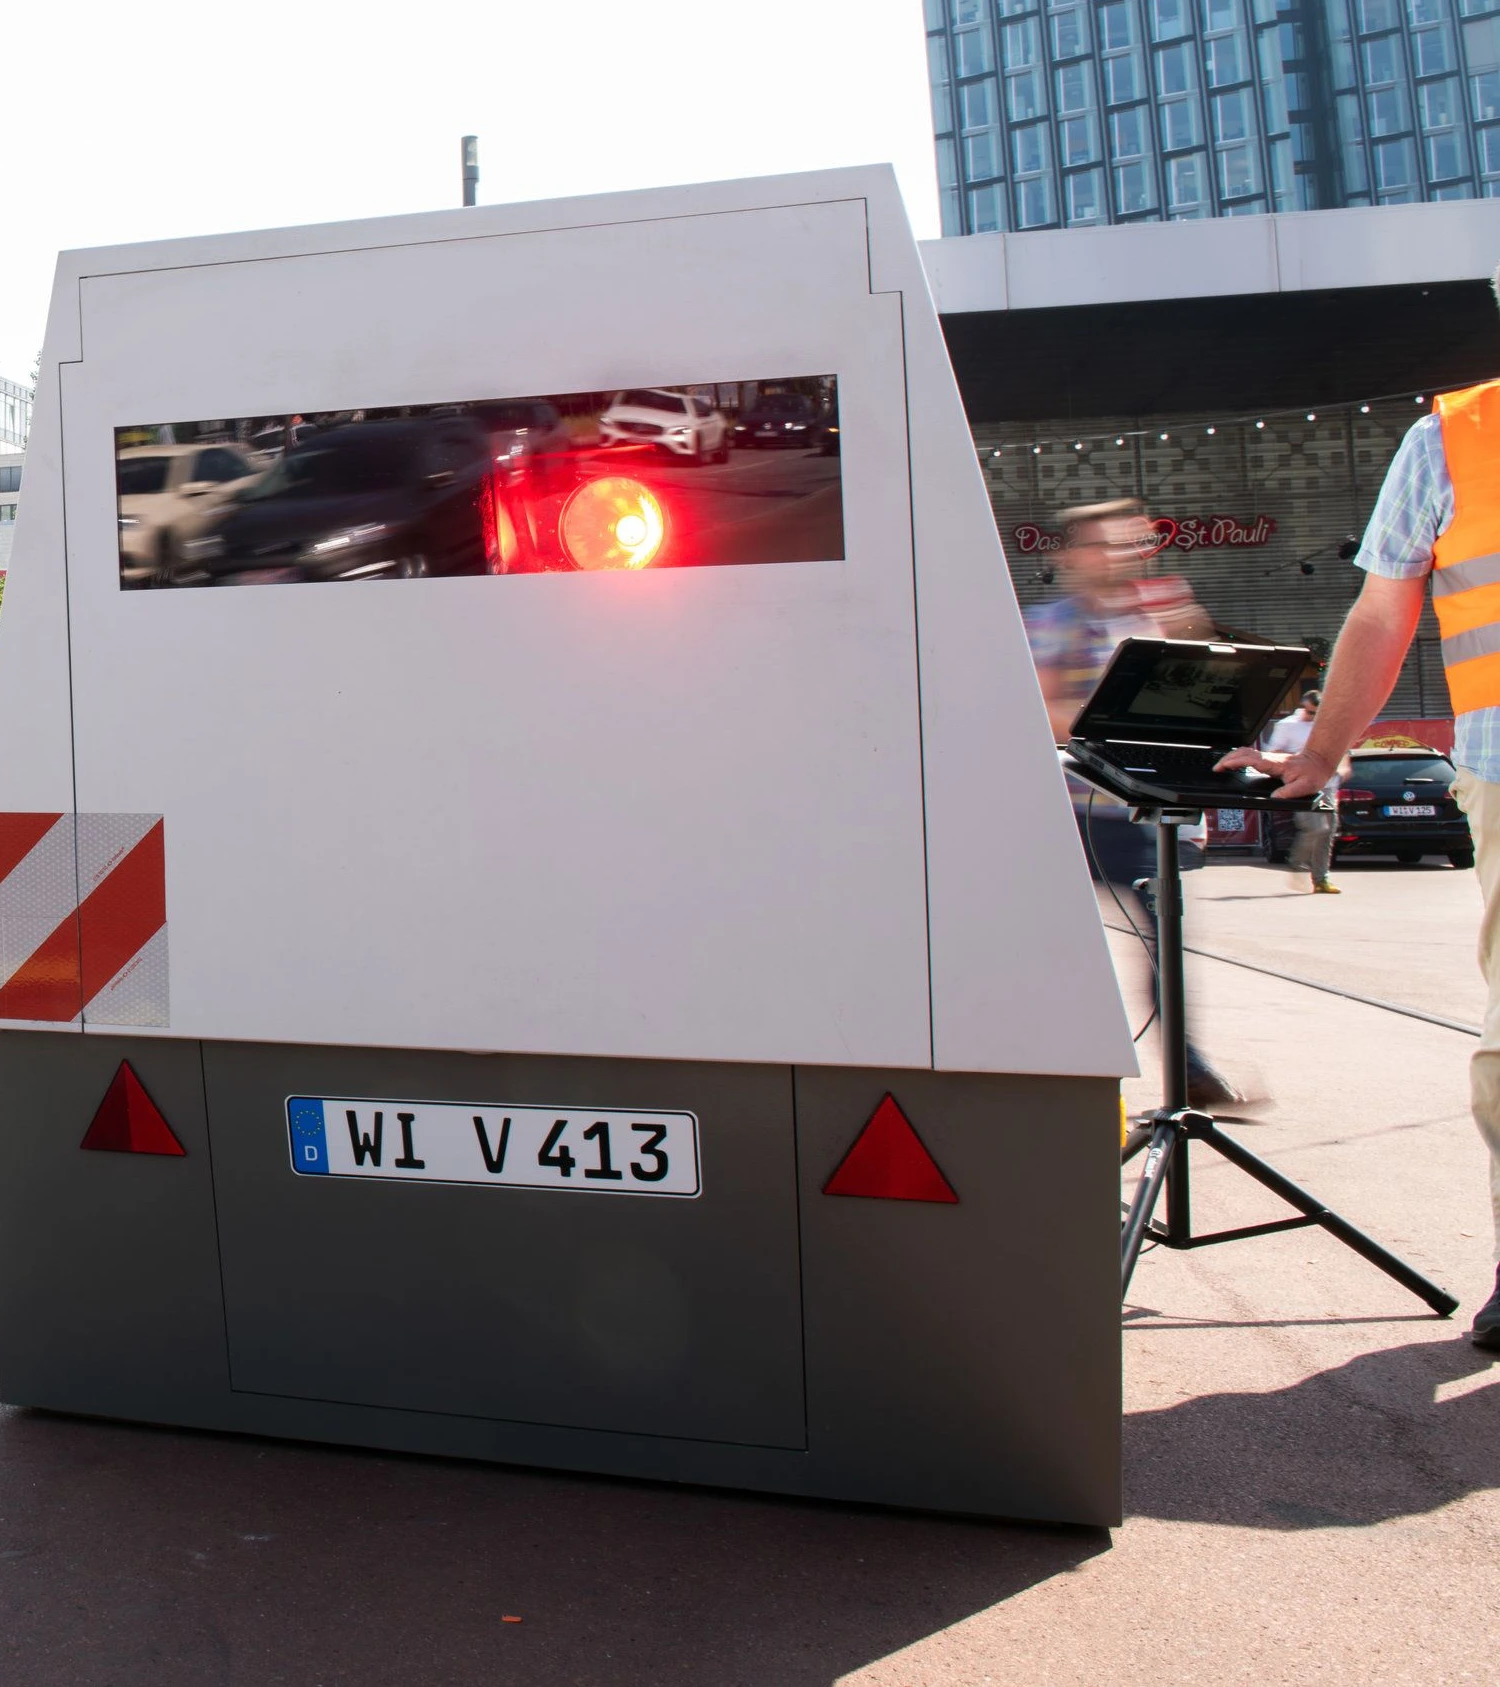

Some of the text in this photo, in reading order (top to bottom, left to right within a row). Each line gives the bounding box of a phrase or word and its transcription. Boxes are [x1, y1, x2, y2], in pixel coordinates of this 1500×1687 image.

[1015, 526, 1060, 551] Das
[1175, 519, 1208, 550] St.
[1211, 517, 1269, 545] Pauli
[304, 1145, 318, 1161] D
[345, 1110, 670, 1182] WI V 413
